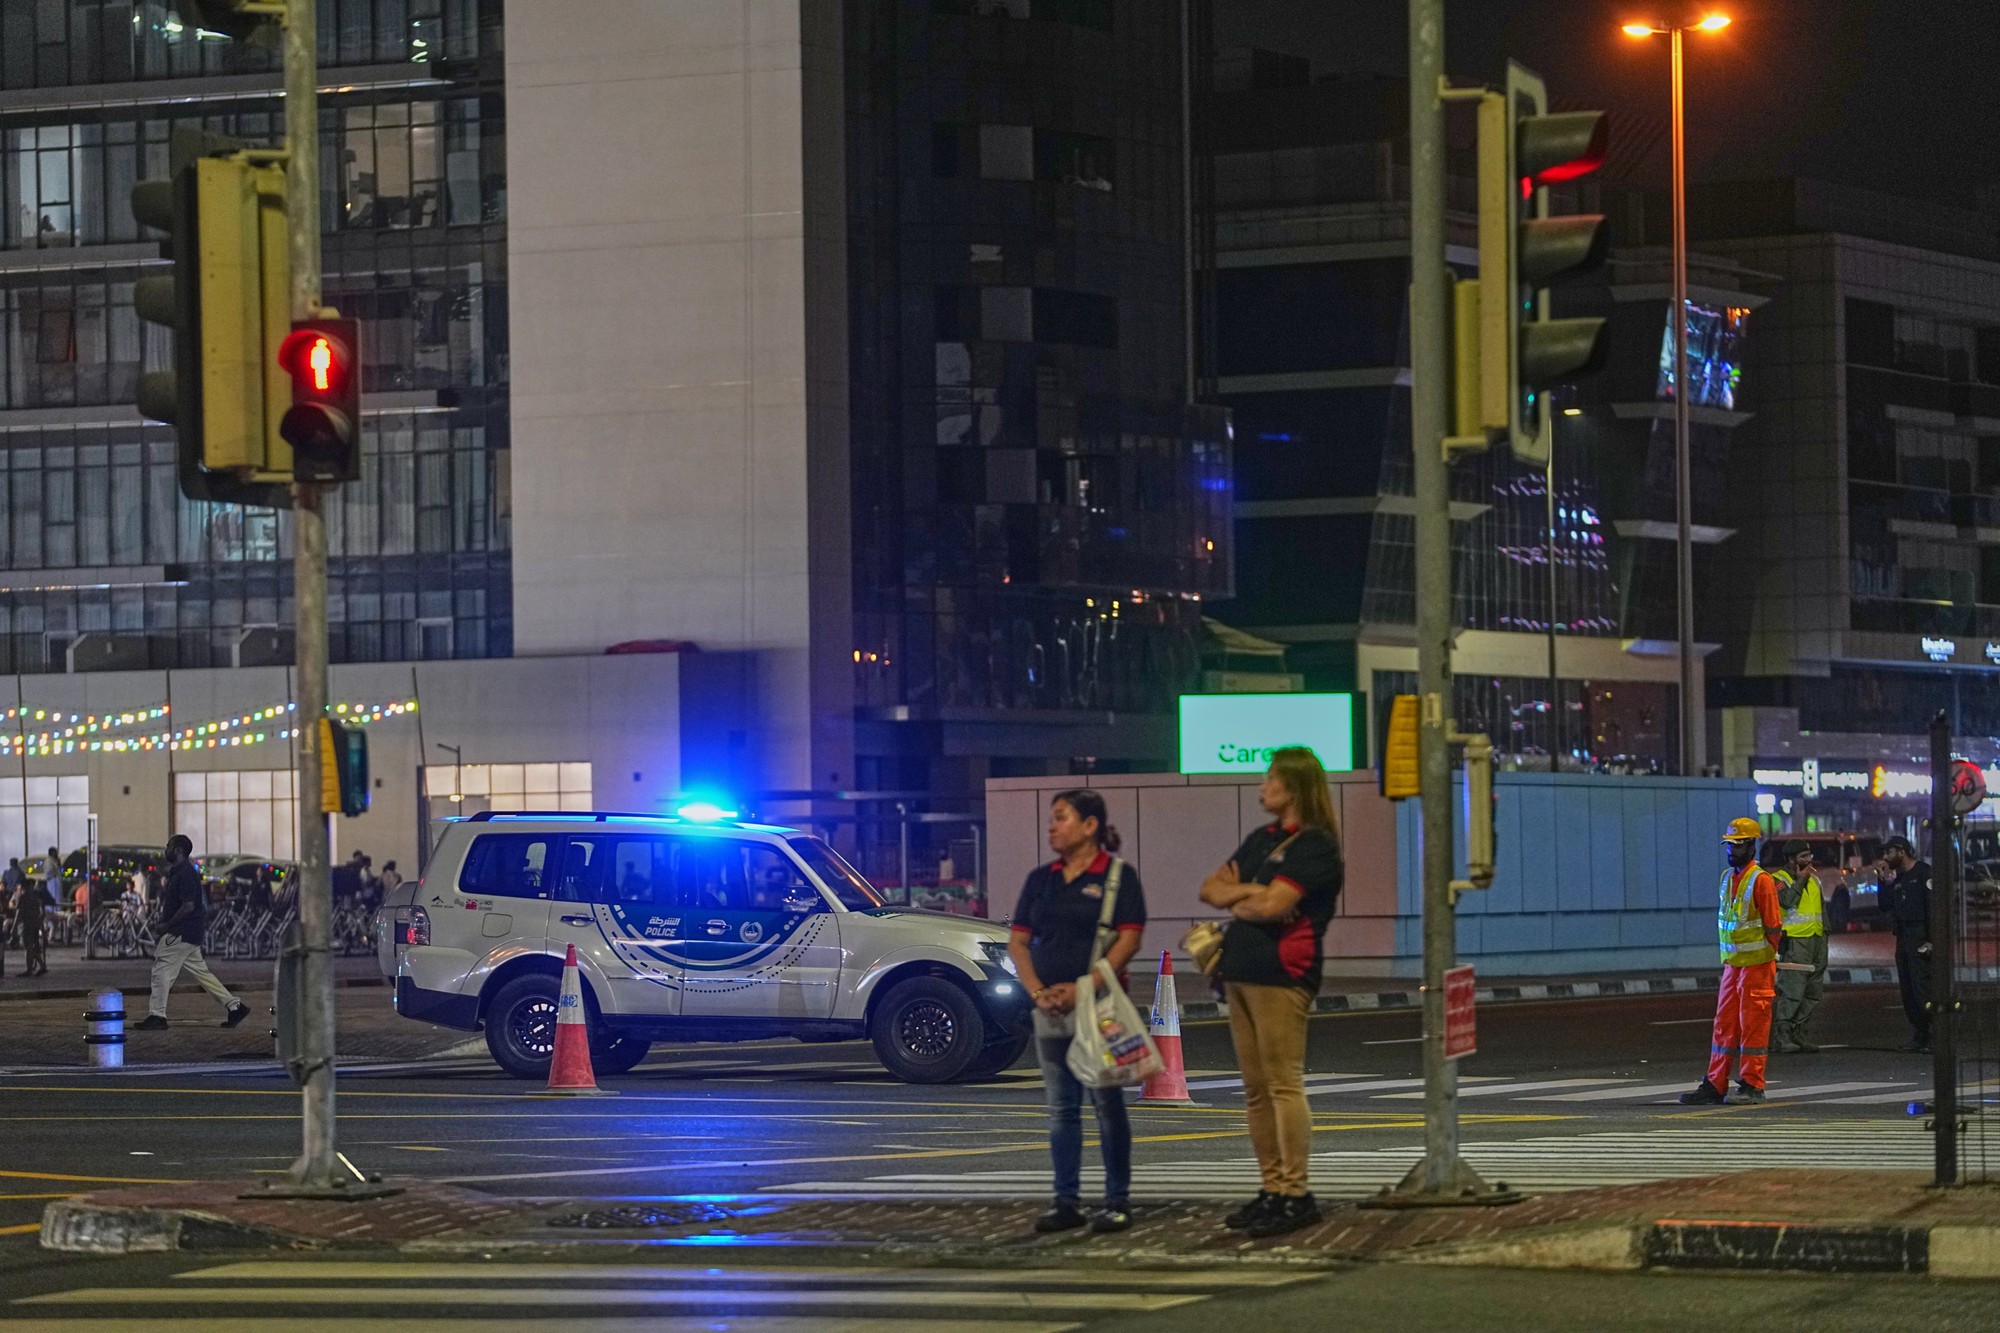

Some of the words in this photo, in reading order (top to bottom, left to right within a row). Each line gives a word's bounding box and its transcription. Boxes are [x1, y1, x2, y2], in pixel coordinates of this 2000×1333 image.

[1218, 744, 1275, 763] Care
[649, 916, 681, 927] الشرطة
[645, 927, 677, 937] POLICE
